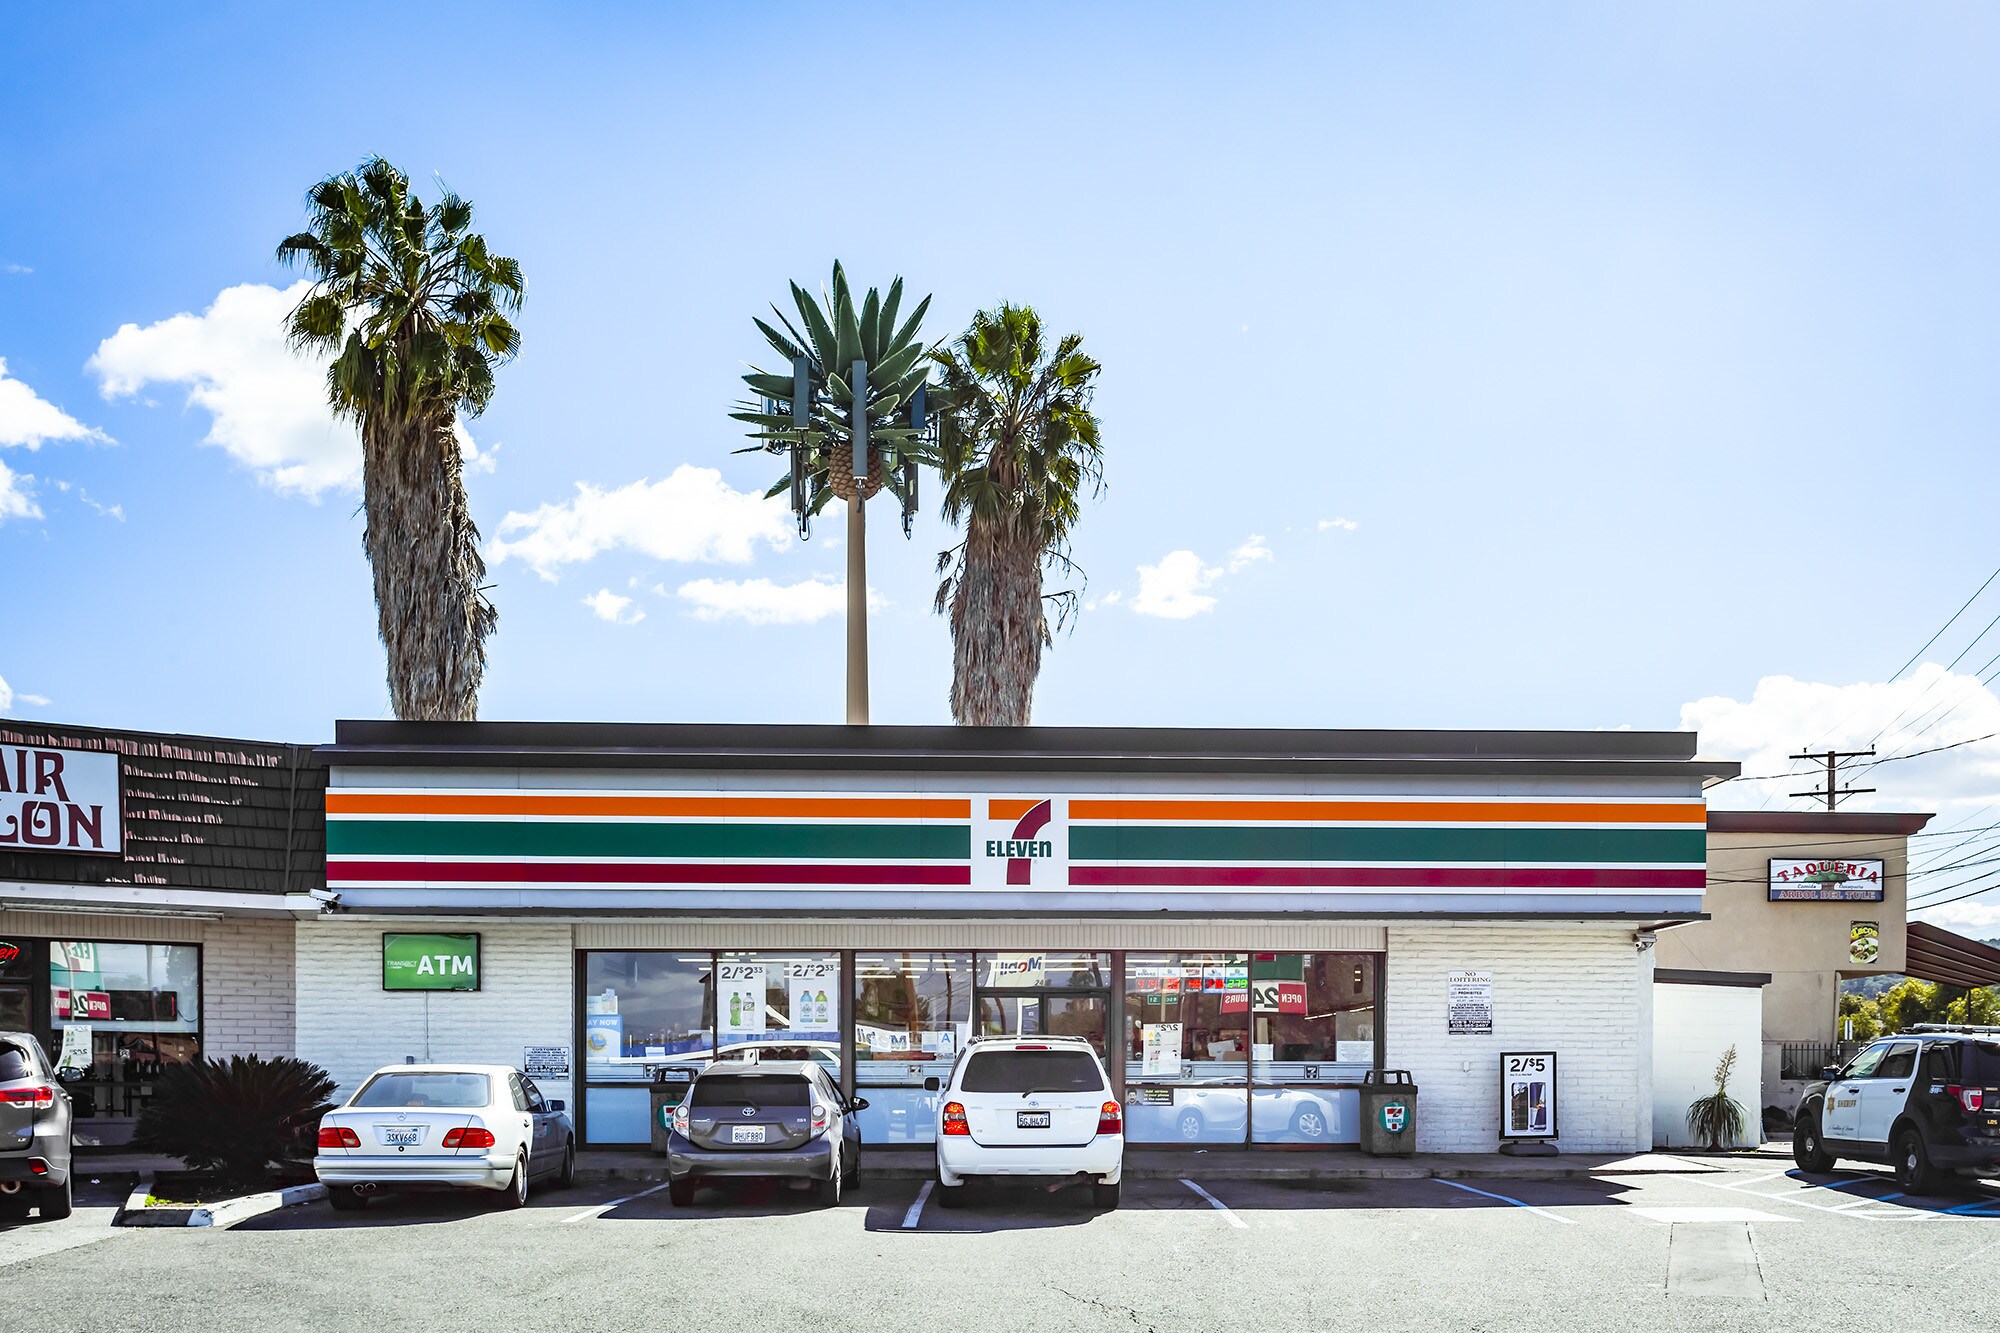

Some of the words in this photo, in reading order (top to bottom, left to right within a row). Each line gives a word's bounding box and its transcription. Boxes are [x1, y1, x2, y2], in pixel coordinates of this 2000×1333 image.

[1777, 861, 1878, 883] TAQUERIA
[1779, 890, 1819, 899] ARBOL
[1820, 890, 1844, 899] DEL
[1845, 890, 1876, 899] TULE
[416, 955, 473, 975] ATM
[941, 1032, 951, 1043] A
[1510, 1057, 1546, 1072] 2/$5
[1837, 1099, 1857, 1108] SHERIFF
[386, 1133, 417, 1142] 3SKV668
